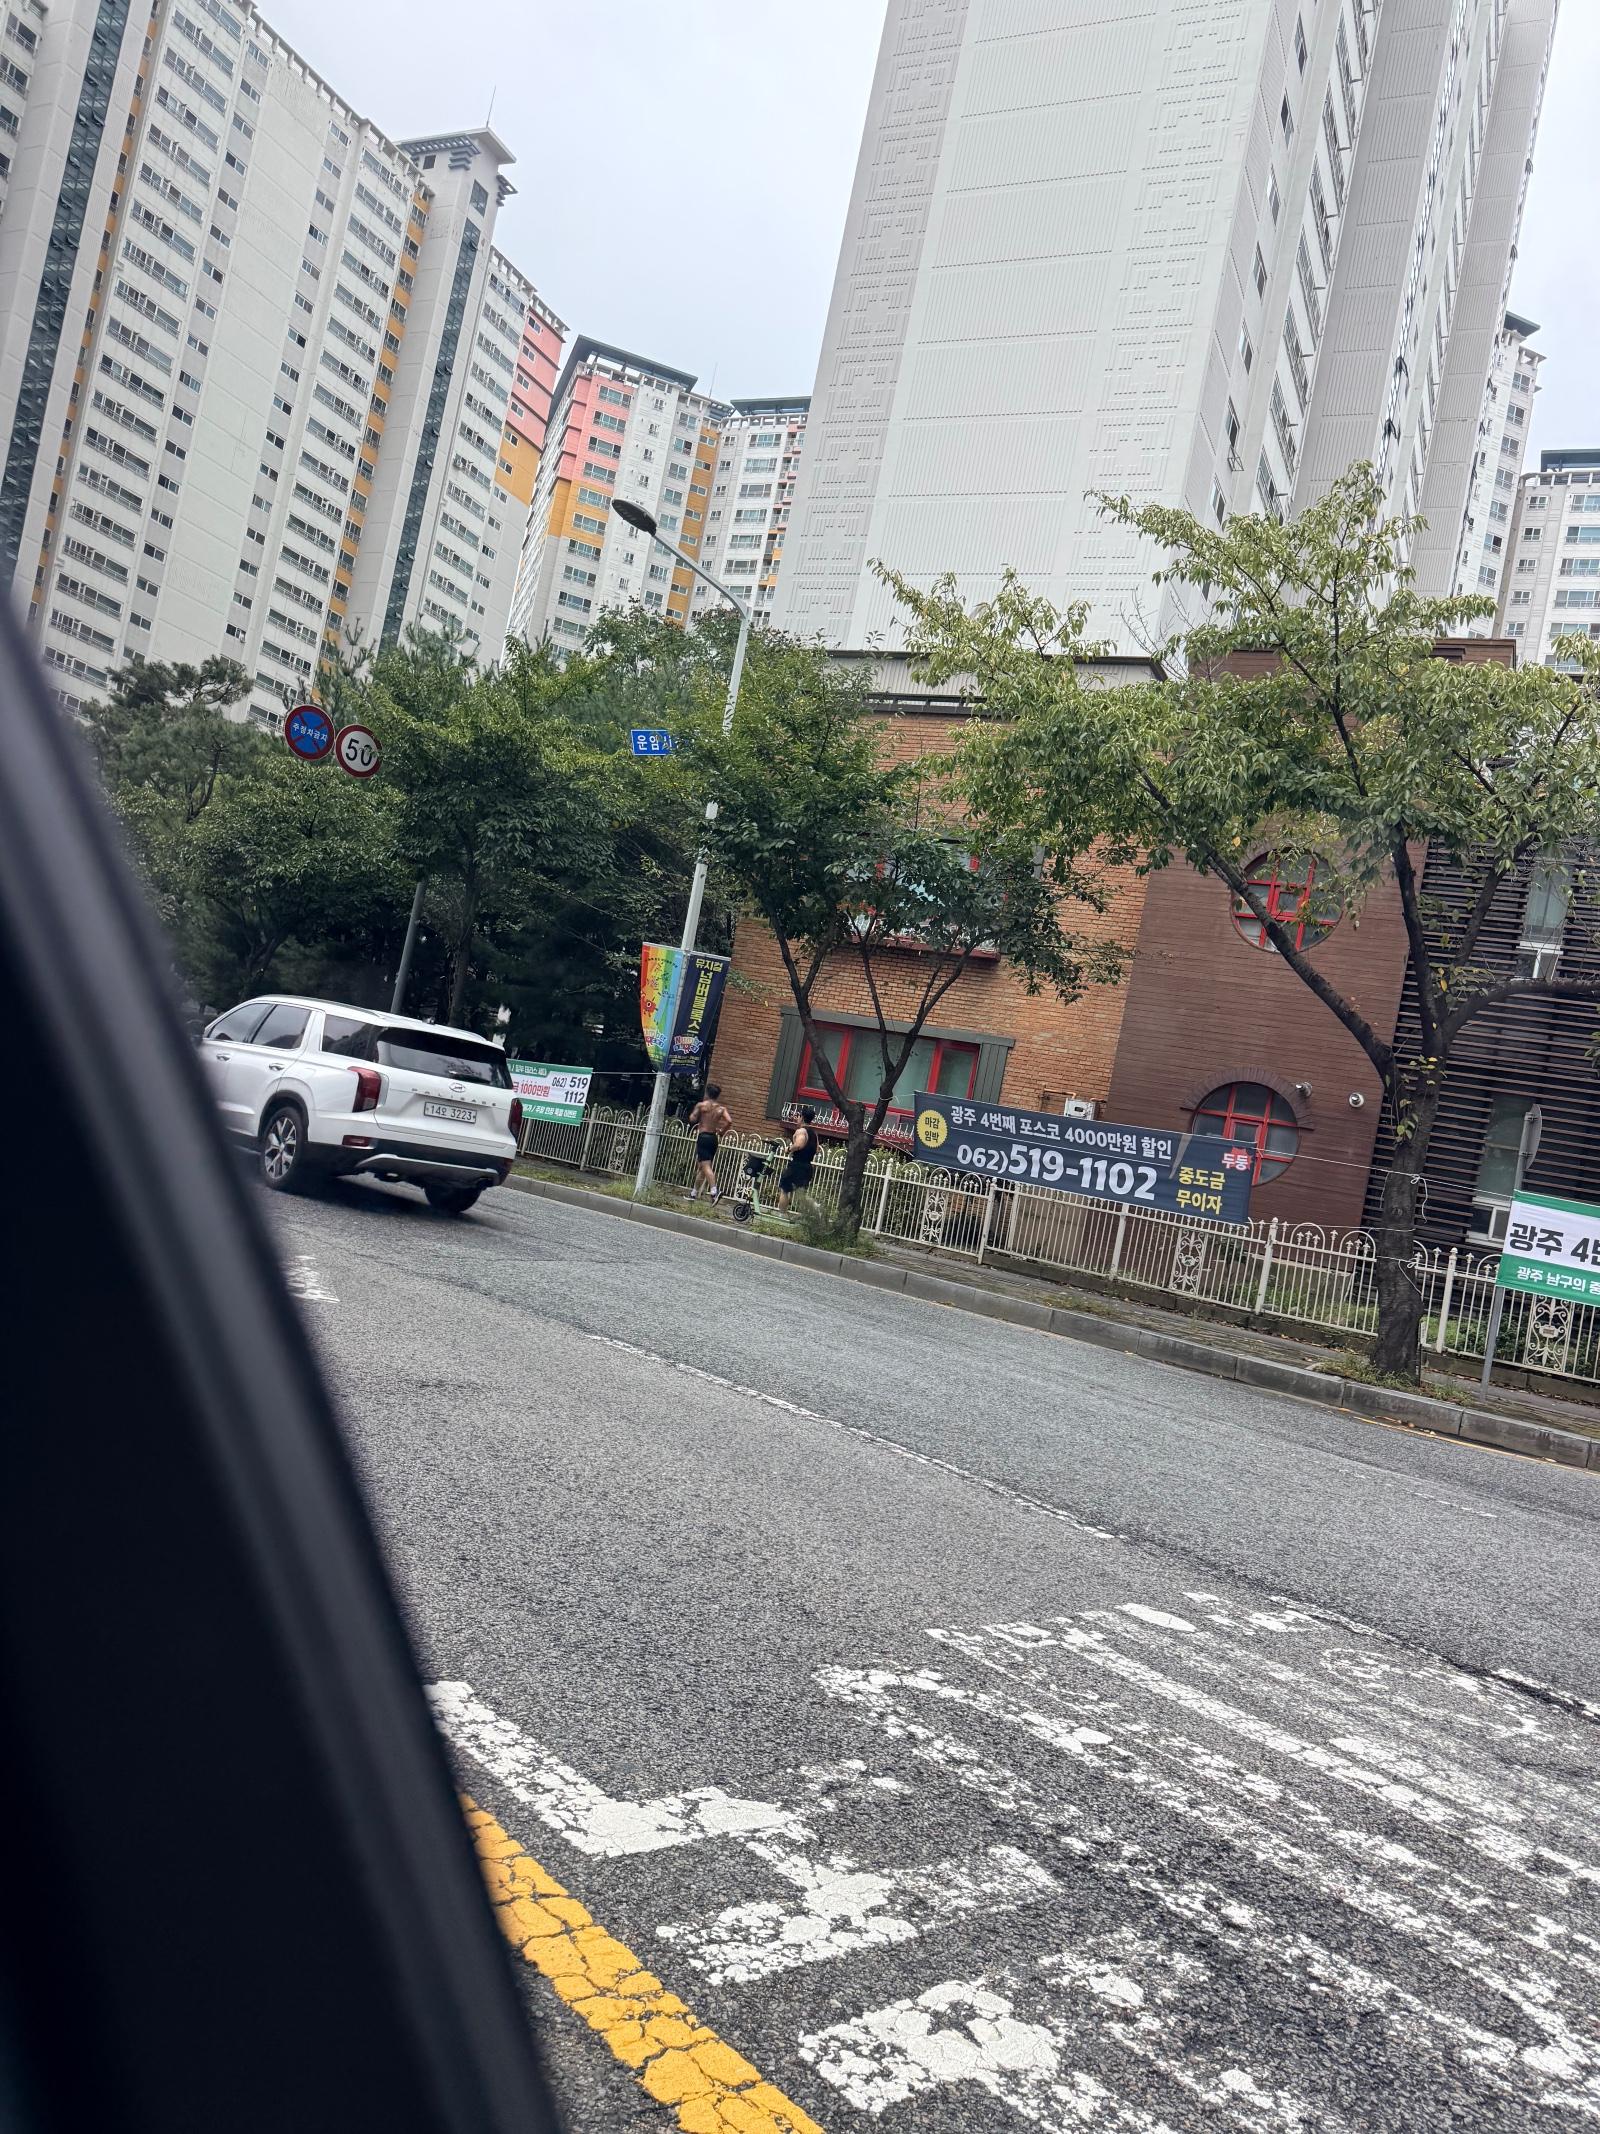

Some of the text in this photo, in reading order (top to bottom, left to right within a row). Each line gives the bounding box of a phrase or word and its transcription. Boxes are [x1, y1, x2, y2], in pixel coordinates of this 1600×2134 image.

[346, 737, 373, 767] 50
[695, 958, 724, 973] 뮤지컬
[520, 1083, 550, 1098] 1000만원
[569, 1076, 588, 1089] 519
[564, 1090, 585, 1104] 1112
[450, 1108, 472, 1121] 3223
[924, 1117, 940, 1130] 마감
[924, 1130, 940, 1143] 임박
[951, 1105, 1172, 1160] 광주 4번째 포스코 4000만원 할인
[1221, 1153, 1249, 1171] 두둥
[1178, 1166, 1226, 1191] 중도금
[1176, 1189, 1223, 1215] 무이자
[1509, 1222, 1564, 1257] 광주
[1517, 1266, 1544, 1282] 광주
[1546, 1272, 1587, 1293] 남구의
